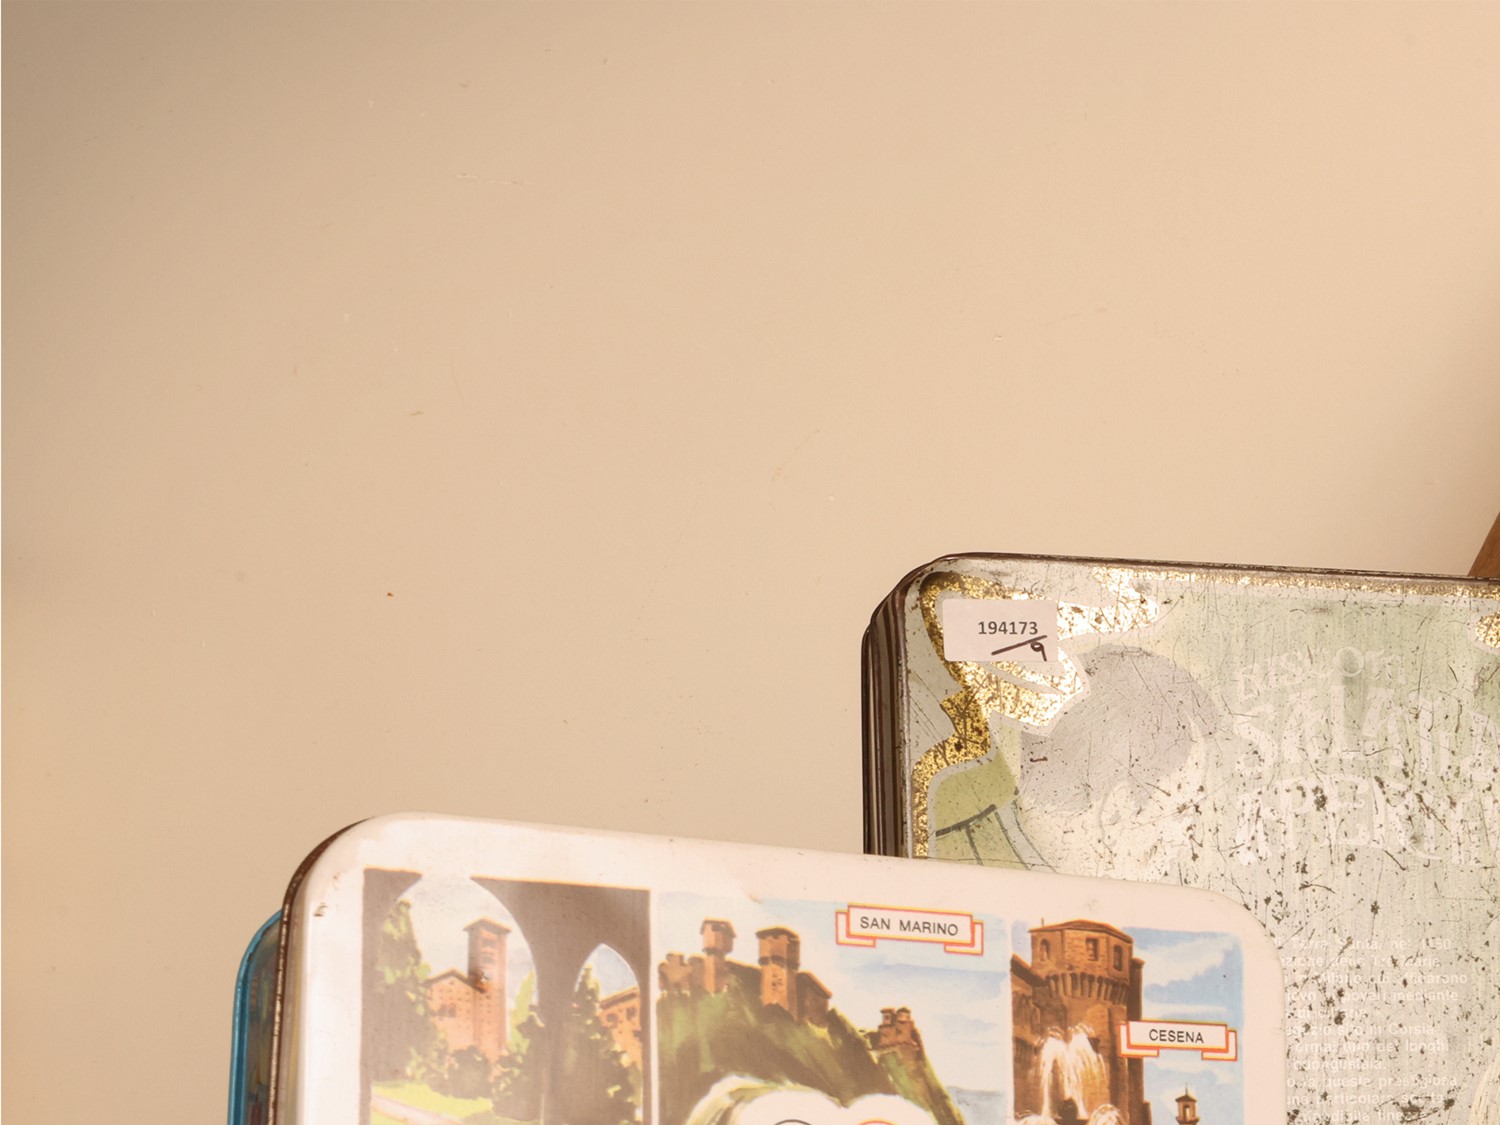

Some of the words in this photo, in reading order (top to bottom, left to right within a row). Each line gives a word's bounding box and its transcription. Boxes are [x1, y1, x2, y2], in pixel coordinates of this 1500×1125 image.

[977, 620, 1039, 635] 194173
[860, 915, 894, 931] SAN
[899, 920, 959, 937] MARINO
[1148, 1028, 1205, 1044] CESENA
